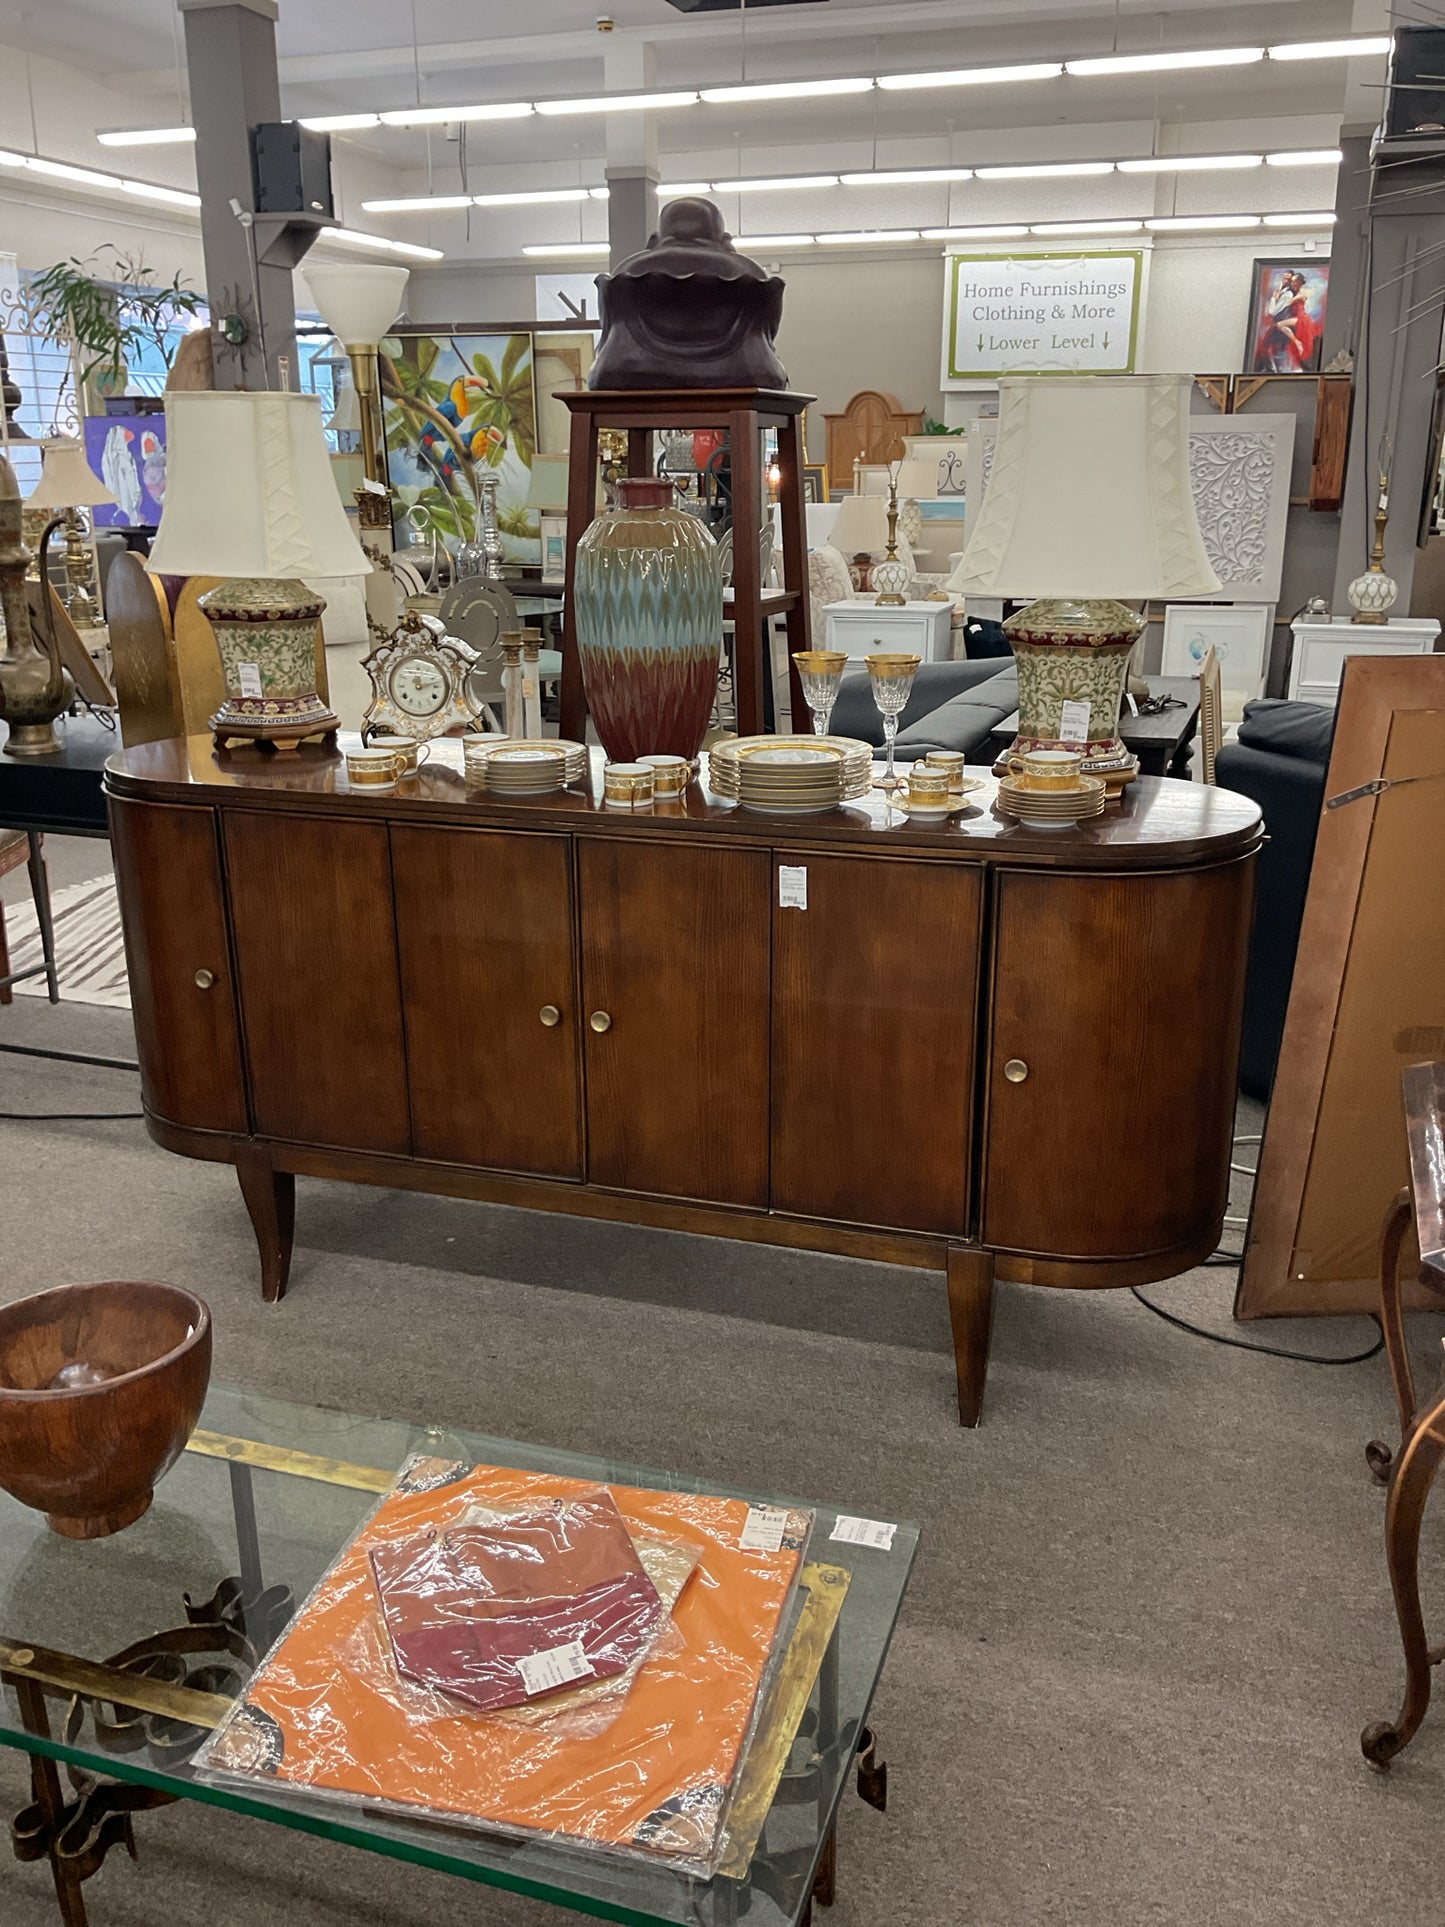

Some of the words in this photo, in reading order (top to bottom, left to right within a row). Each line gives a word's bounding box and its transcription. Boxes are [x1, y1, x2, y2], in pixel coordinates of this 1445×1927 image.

[964, 284, 1014, 298] Home
[1019, 280, 1127, 299] Furnishings
[972, 305, 1046, 324] Clothing
[1051, 304, 1066, 319] &
[1071, 304, 1116, 319] More
[988, 336, 1040, 350] Lower
[1051, 334, 1095, 349] Level
